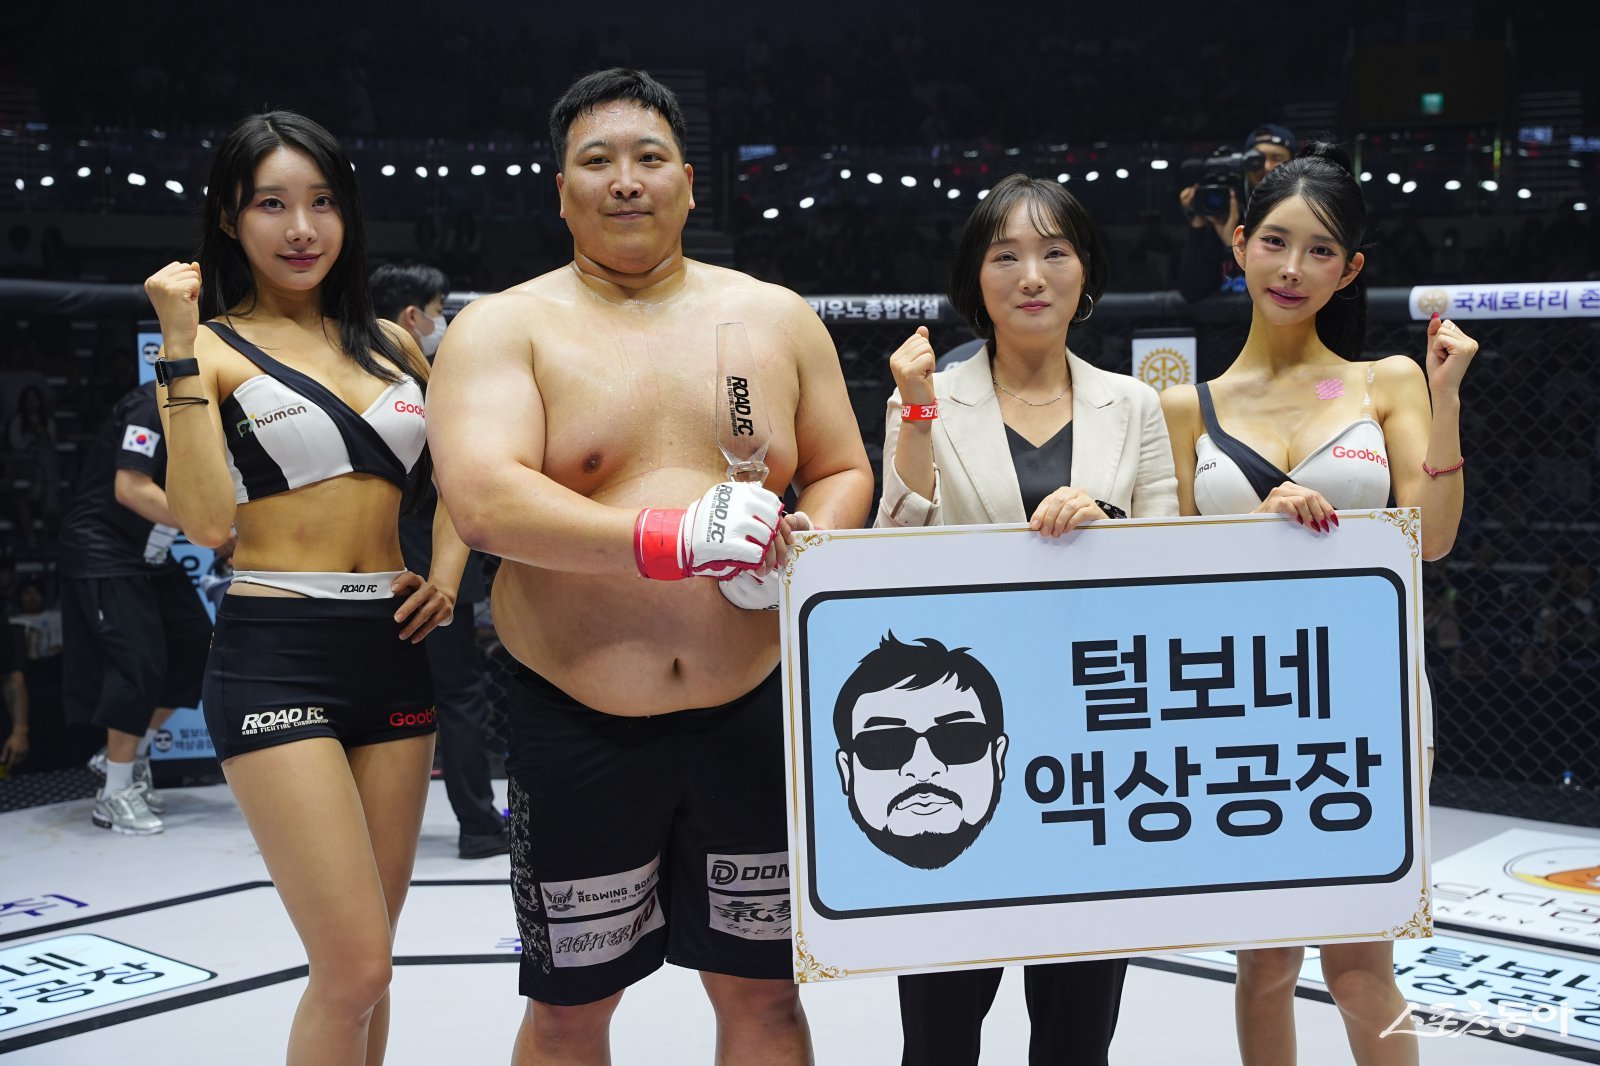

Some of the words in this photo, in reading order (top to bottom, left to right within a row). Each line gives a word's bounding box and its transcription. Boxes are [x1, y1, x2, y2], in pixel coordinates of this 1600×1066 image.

[1454, 289, 1568, 312] 국제로타리
[732, 376, 751, 415] ROAD
[254, 405, 307, 428] human
[737, 418, 753, 436] FC
[715, 485, 733, 520] ROAD
[711, 522, 726, 543] FC
[340, 585, 365, 593] ROAD
[366, 585, 377, 593] FC
[1072, 626, 1330, 732] 털보네
[241, 708, 302, 730] ROAD
[306, 706, 324, 721] FC
[1024, 736, 1382, 846] 액상공장
[578, 887, 628, 903] REDWING
[0, 961, 165, 1016] 공장
